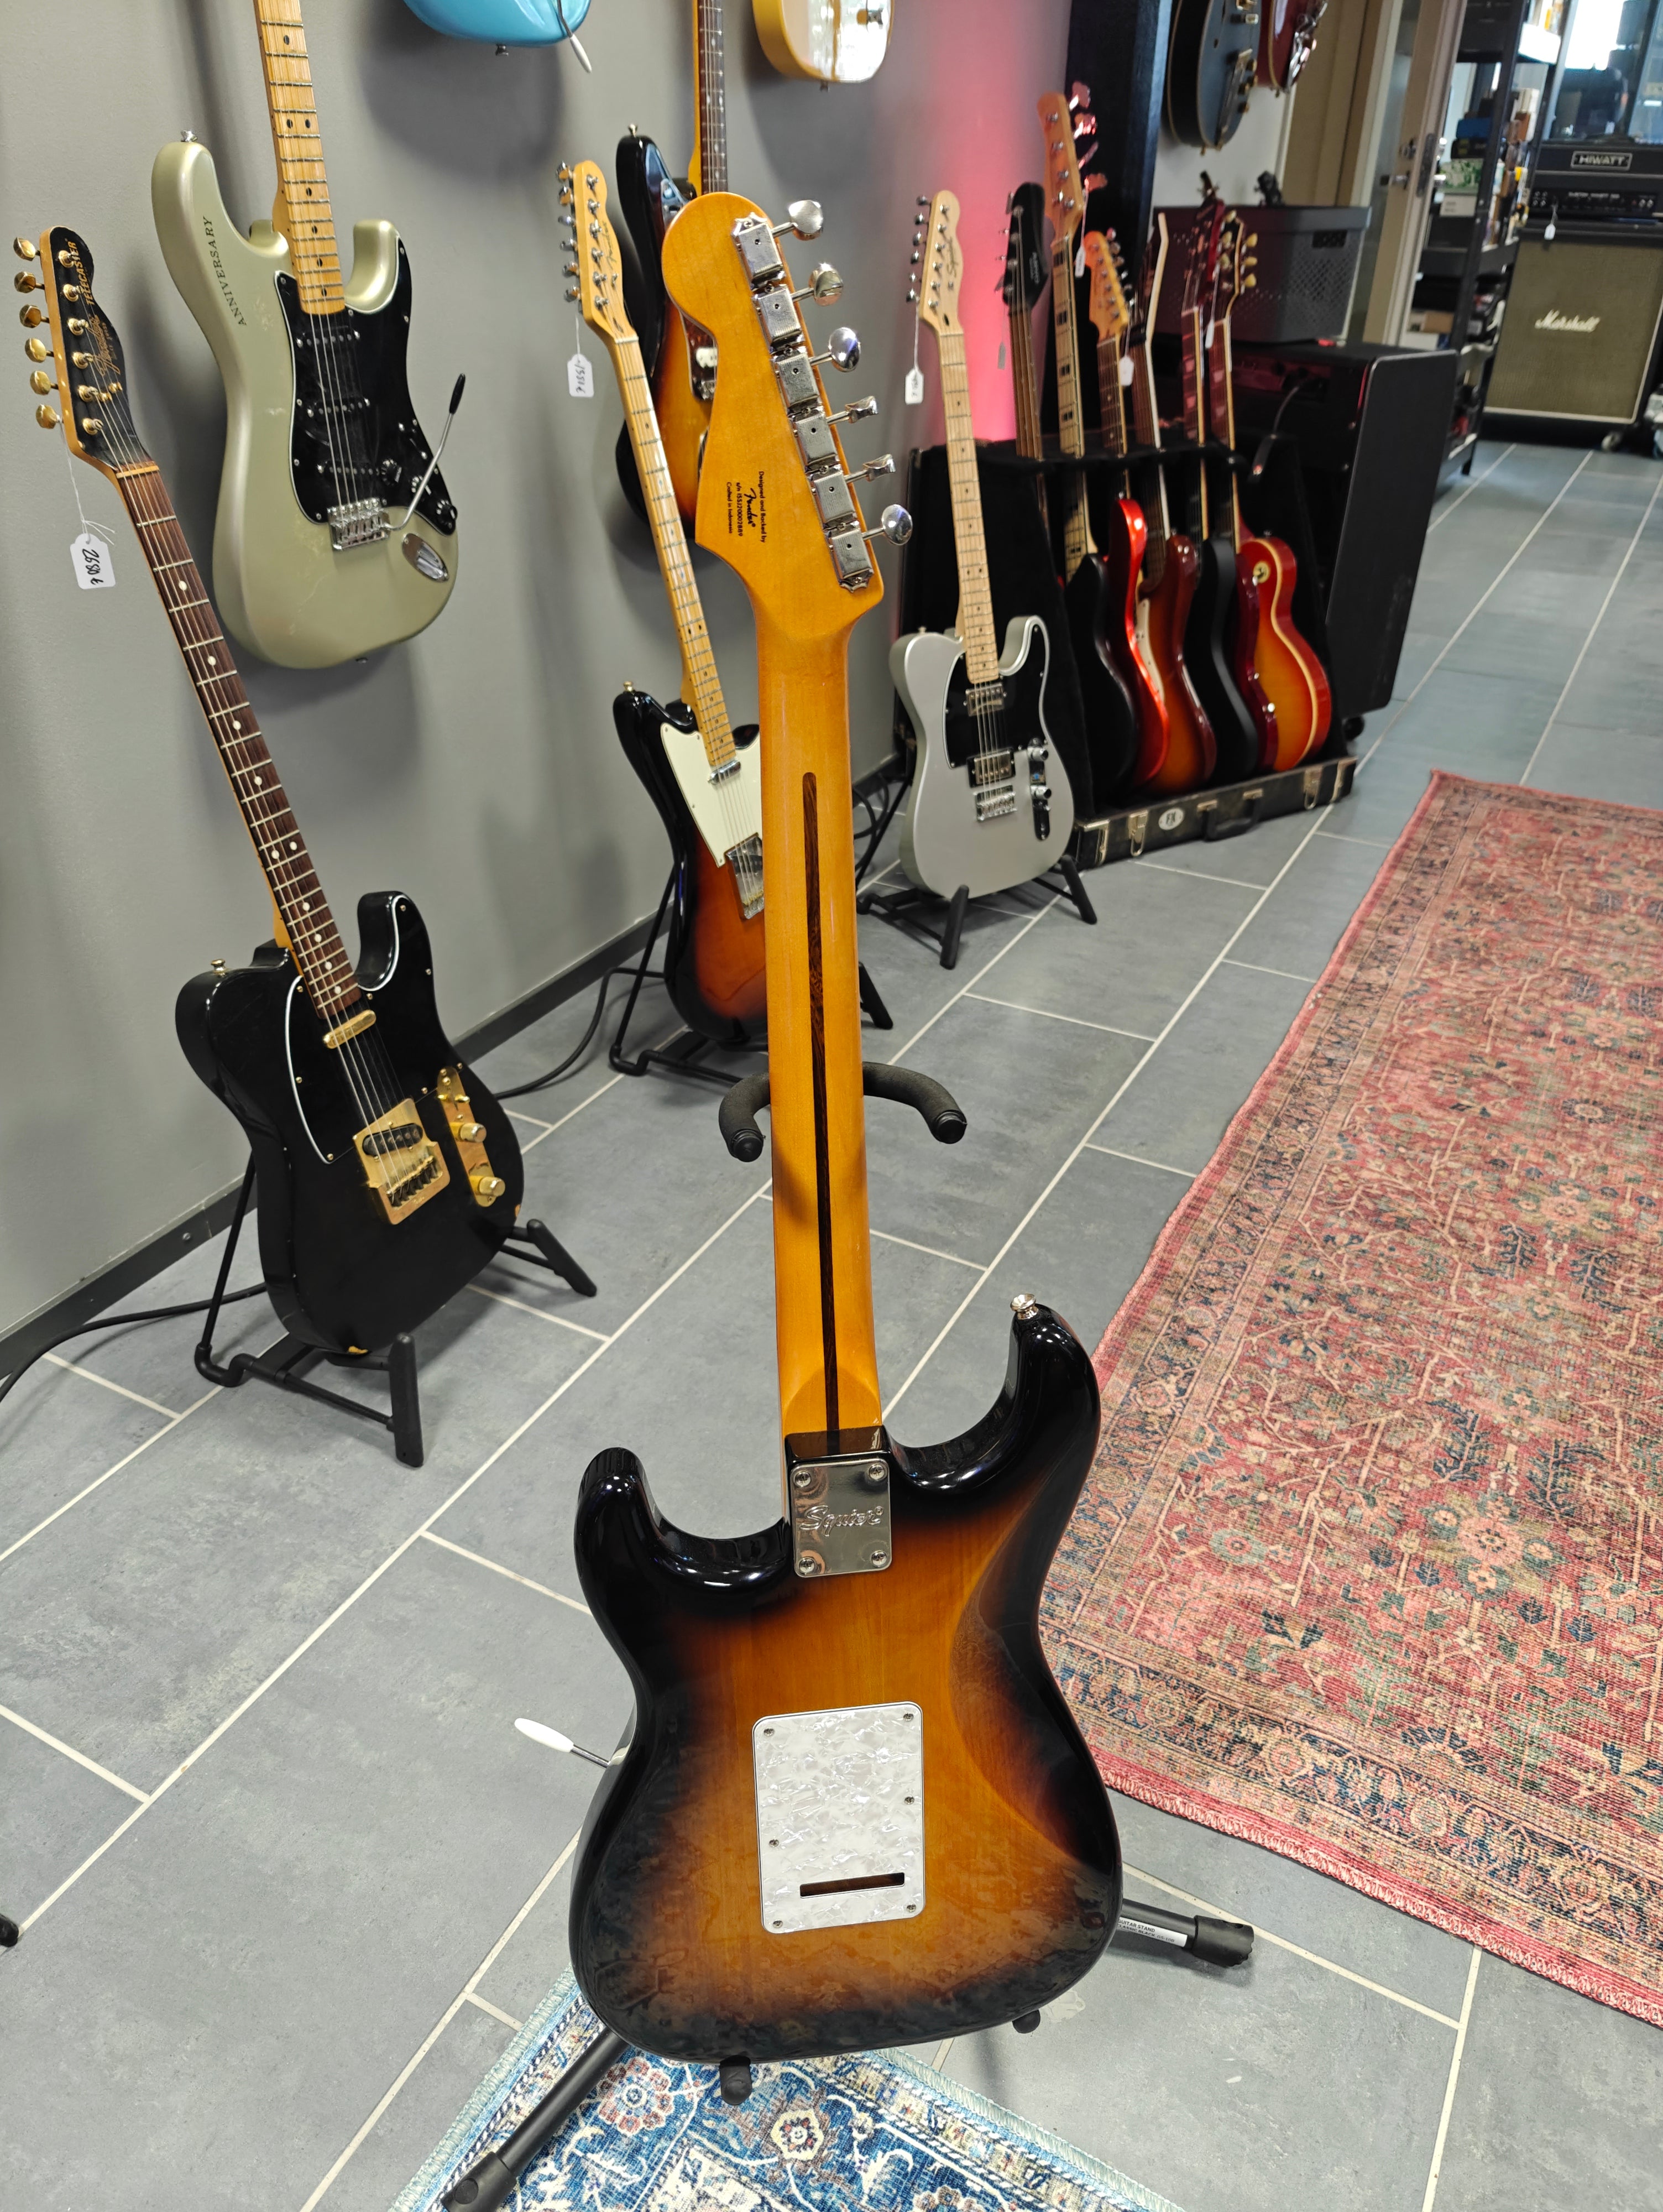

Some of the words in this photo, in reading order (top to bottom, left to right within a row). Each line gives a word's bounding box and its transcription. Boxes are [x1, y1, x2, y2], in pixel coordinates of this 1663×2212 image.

[1579, 155, 1625, 166] HIWATT
[202, 215, 248, 326] ANNIVERSARY
[1534, 309, 1601, 333] Marshall
[87, 314, 121, 376] Fender
[744, 487, 758, 524] Fender
[82, 549, 101, 575] 2680
[799, 1505, 882, 1537] Squier
[1117, 1919, 1137, 1928] GUITAR
[1137, 1924, 1155, 1933] STAND
[1117, 1923, 1137, 1932] LASSIC
